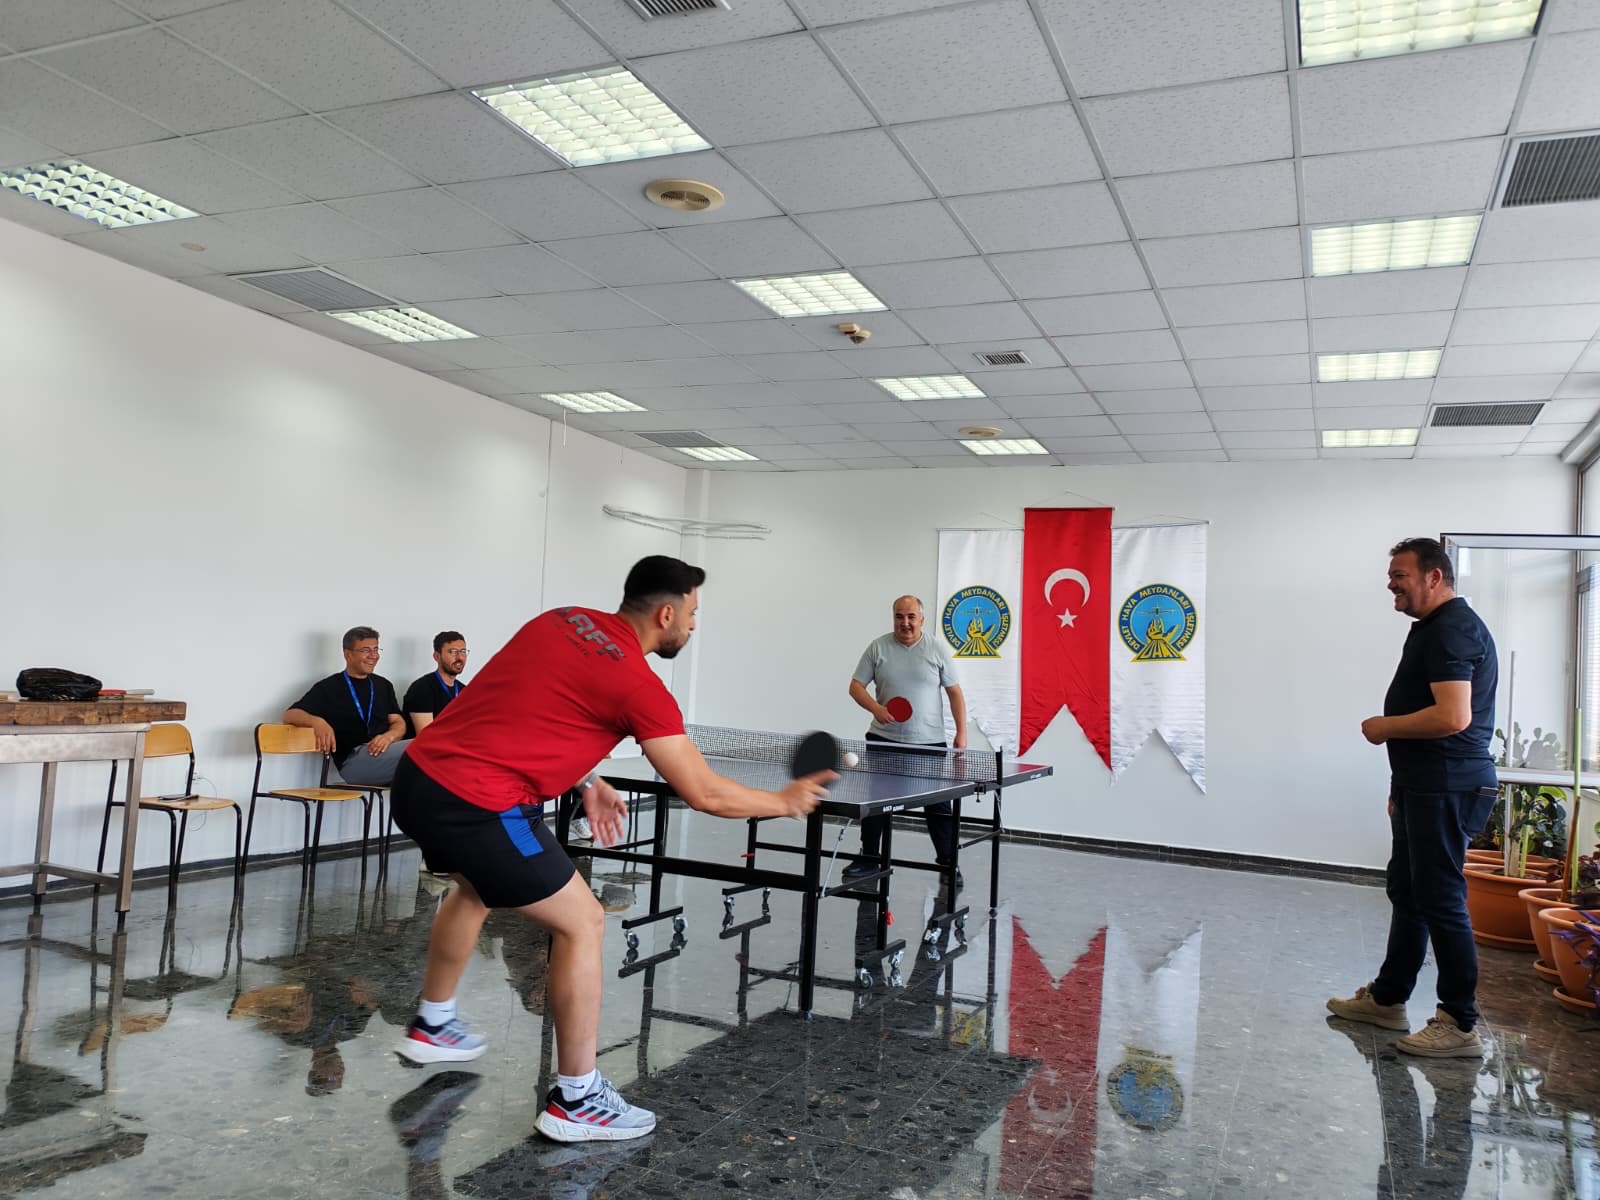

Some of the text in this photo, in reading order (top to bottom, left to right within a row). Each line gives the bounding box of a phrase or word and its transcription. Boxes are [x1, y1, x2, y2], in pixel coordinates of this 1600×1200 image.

[944, 598, 960, 619] HAVA
[961, 588, 1006, 609] MEYDANLARI
[1139, 587, 1190, 609] MEYDANLARI
[1121, 599, 1137, 621] HAVA
[944, 624, 960, 646] DEVLET
[1122, 626, 1140, 649] DEVLET
